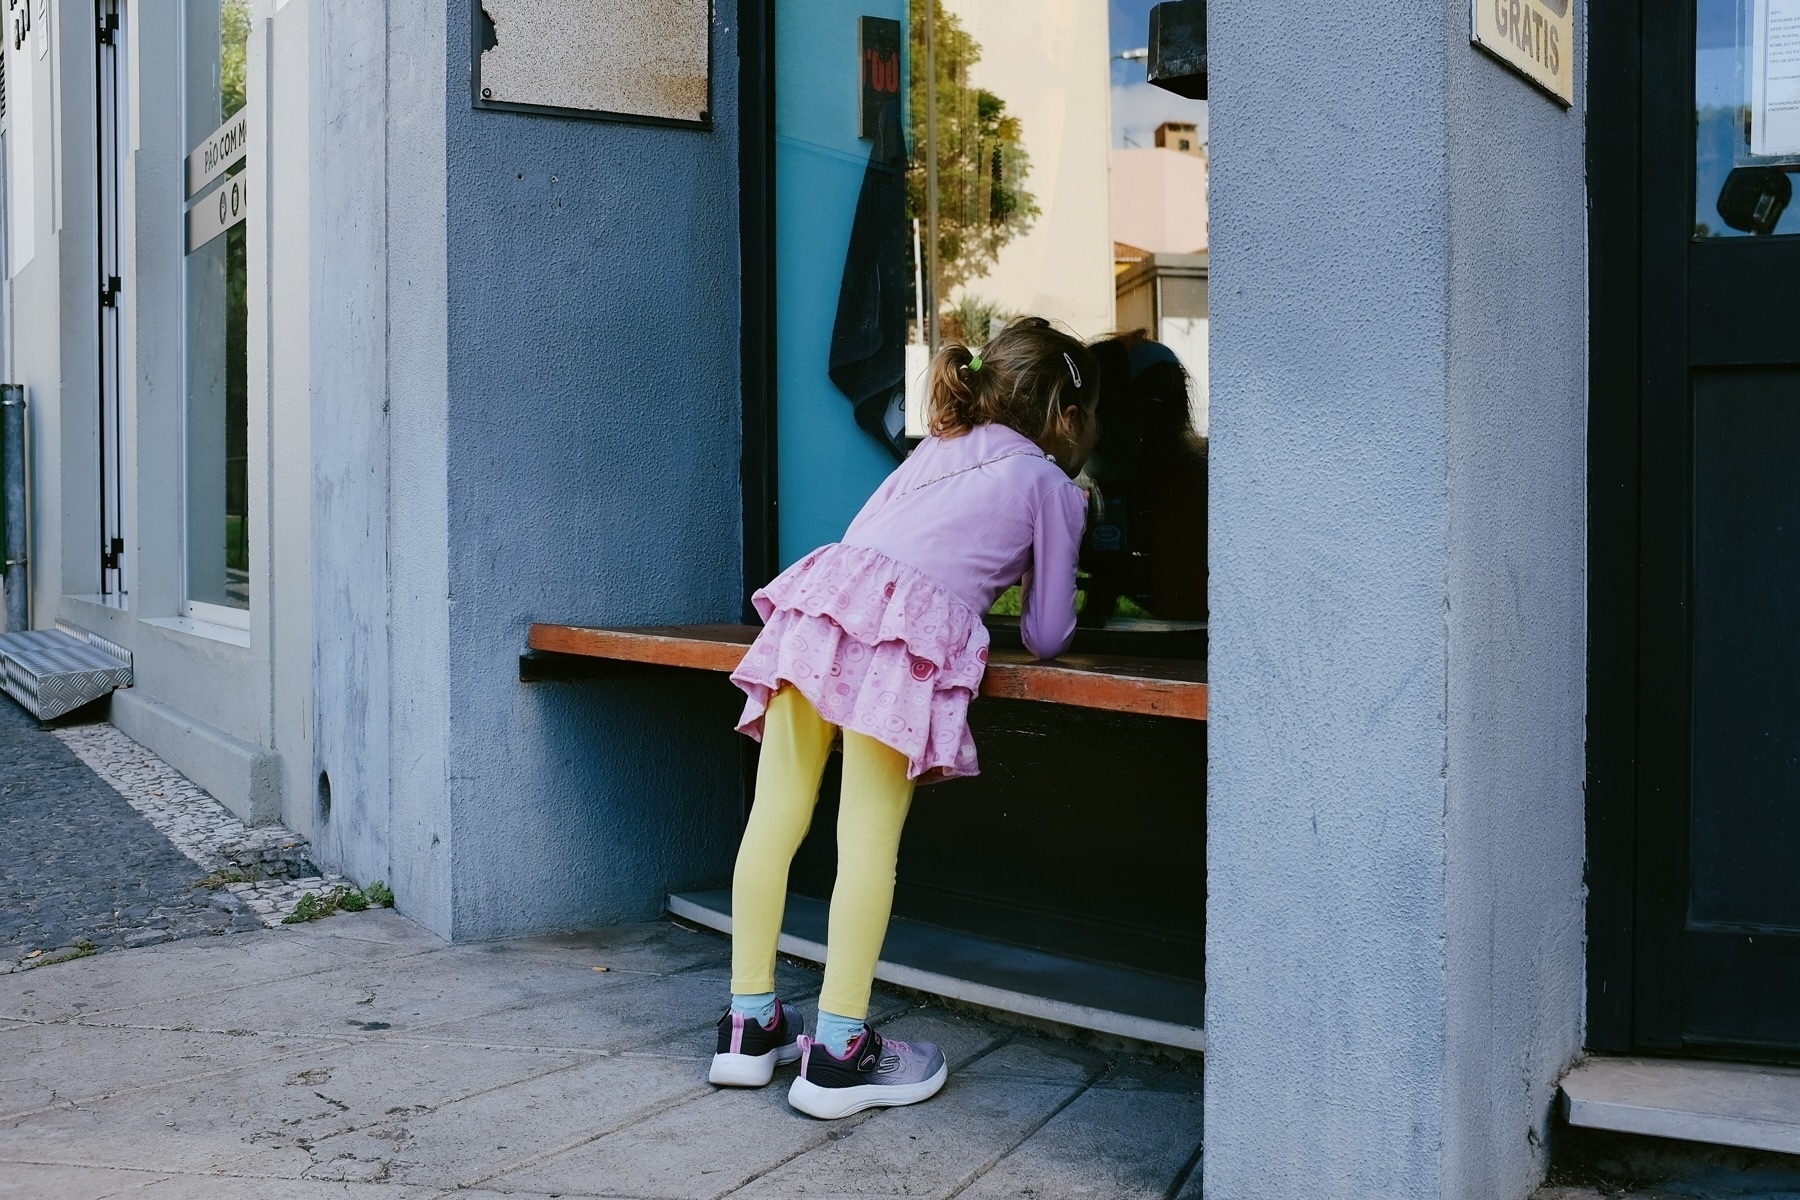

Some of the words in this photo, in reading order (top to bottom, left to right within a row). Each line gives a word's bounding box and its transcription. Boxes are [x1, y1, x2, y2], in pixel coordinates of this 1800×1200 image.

[1495, 0, 1559, 75] GRATIS
[204, 141, 219, 174] PÃO
[220, 130, 237, 160] COM
[239, 119, 247, 146] M
